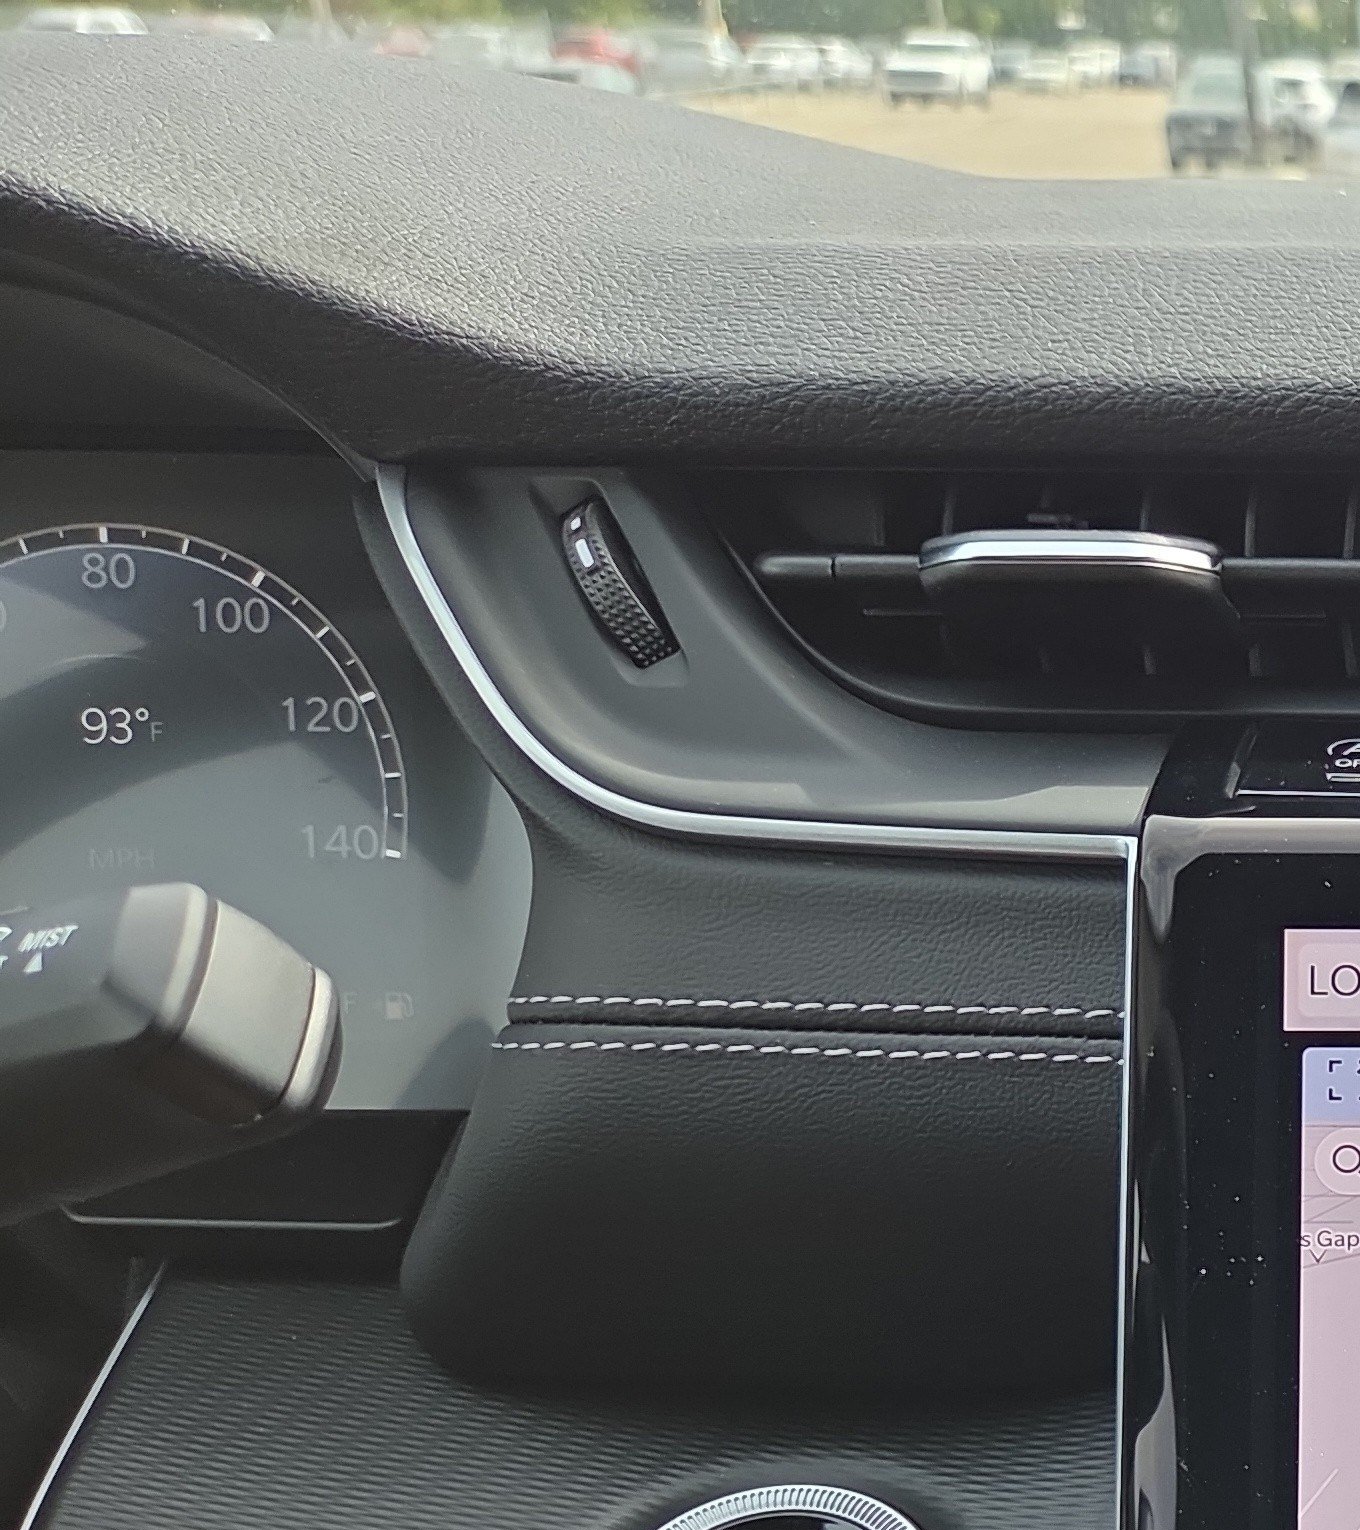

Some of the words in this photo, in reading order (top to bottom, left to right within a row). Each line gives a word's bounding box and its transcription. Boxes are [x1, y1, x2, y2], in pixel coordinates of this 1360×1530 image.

[81, 553, 136, 590] 80
[191, 597, 271, 634] 100
[281, 696, 360, 734] 120
[302, 824, 379, 860] 140
[17, 924, 79, 952] MIST
[1317, 1230, 1360, 1251] Gap
